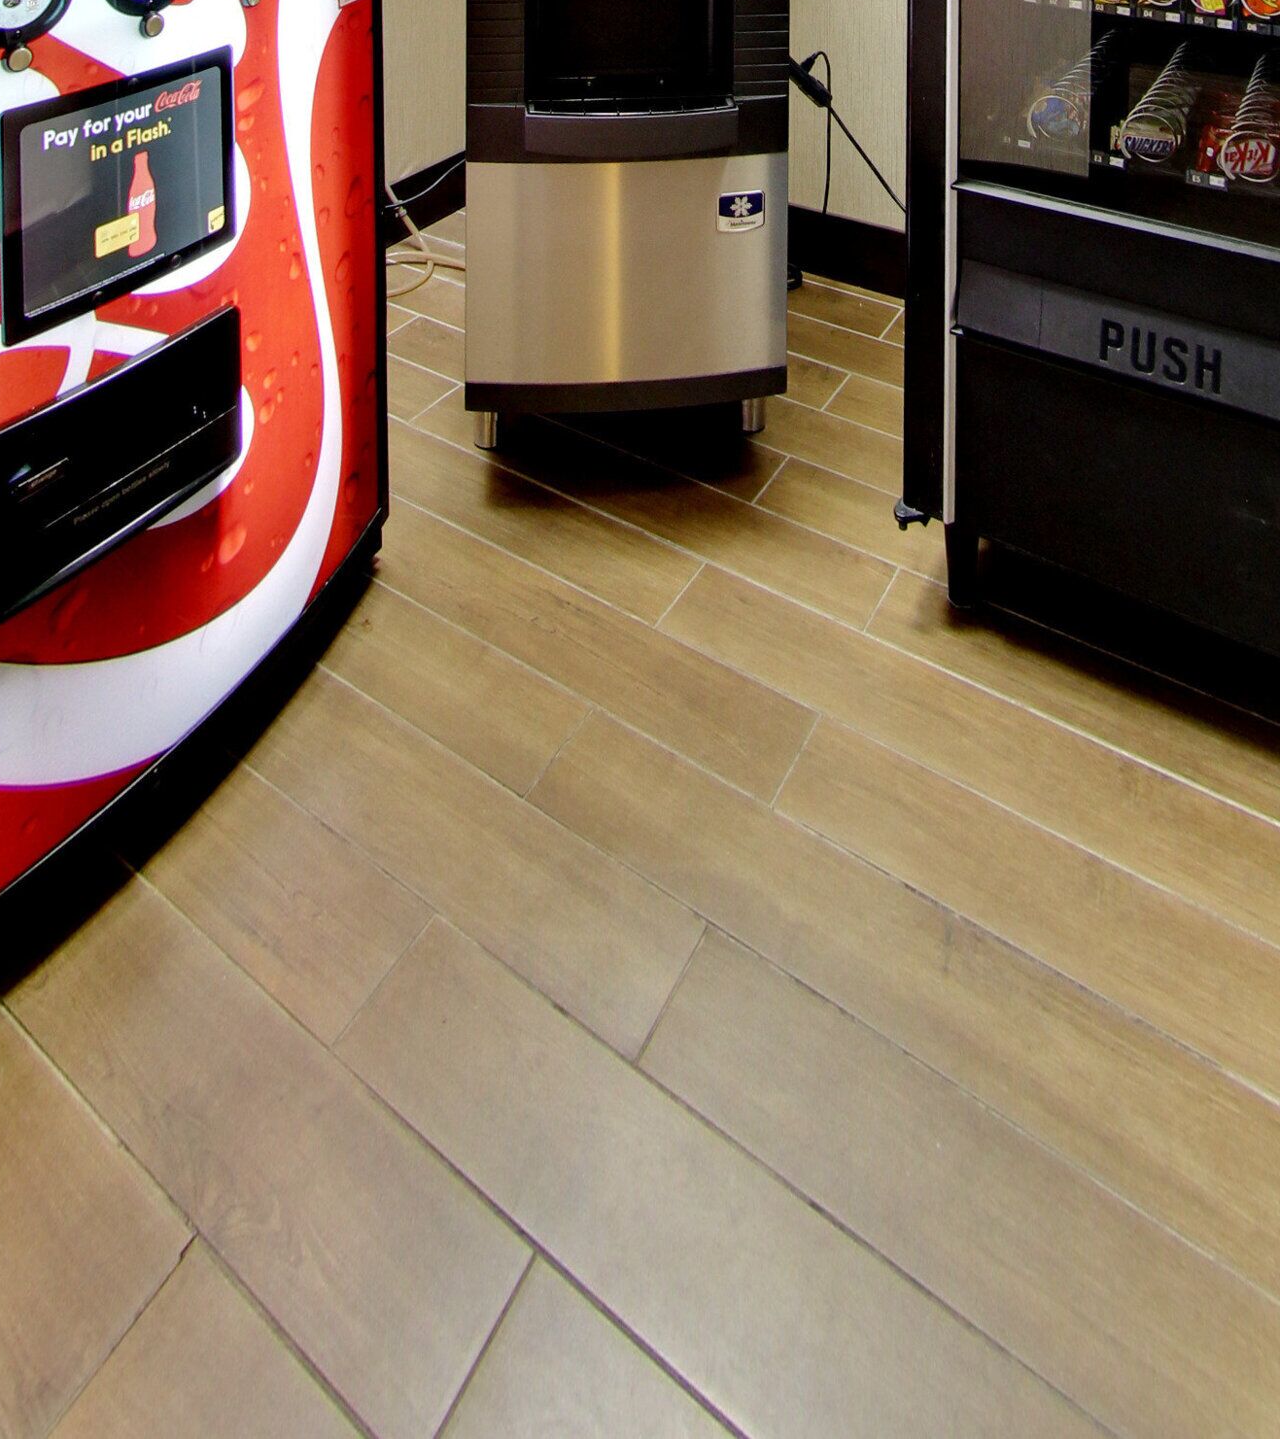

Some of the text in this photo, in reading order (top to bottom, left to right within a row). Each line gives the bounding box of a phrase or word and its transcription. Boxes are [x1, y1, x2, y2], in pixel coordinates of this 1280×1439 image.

[42, 79, 203, 152] Pay for your Coca-Cola
[90, 142, 107, 162] in
[111, 139, 124, 154] a
[1099, 317, 1222, 396] PUSH
